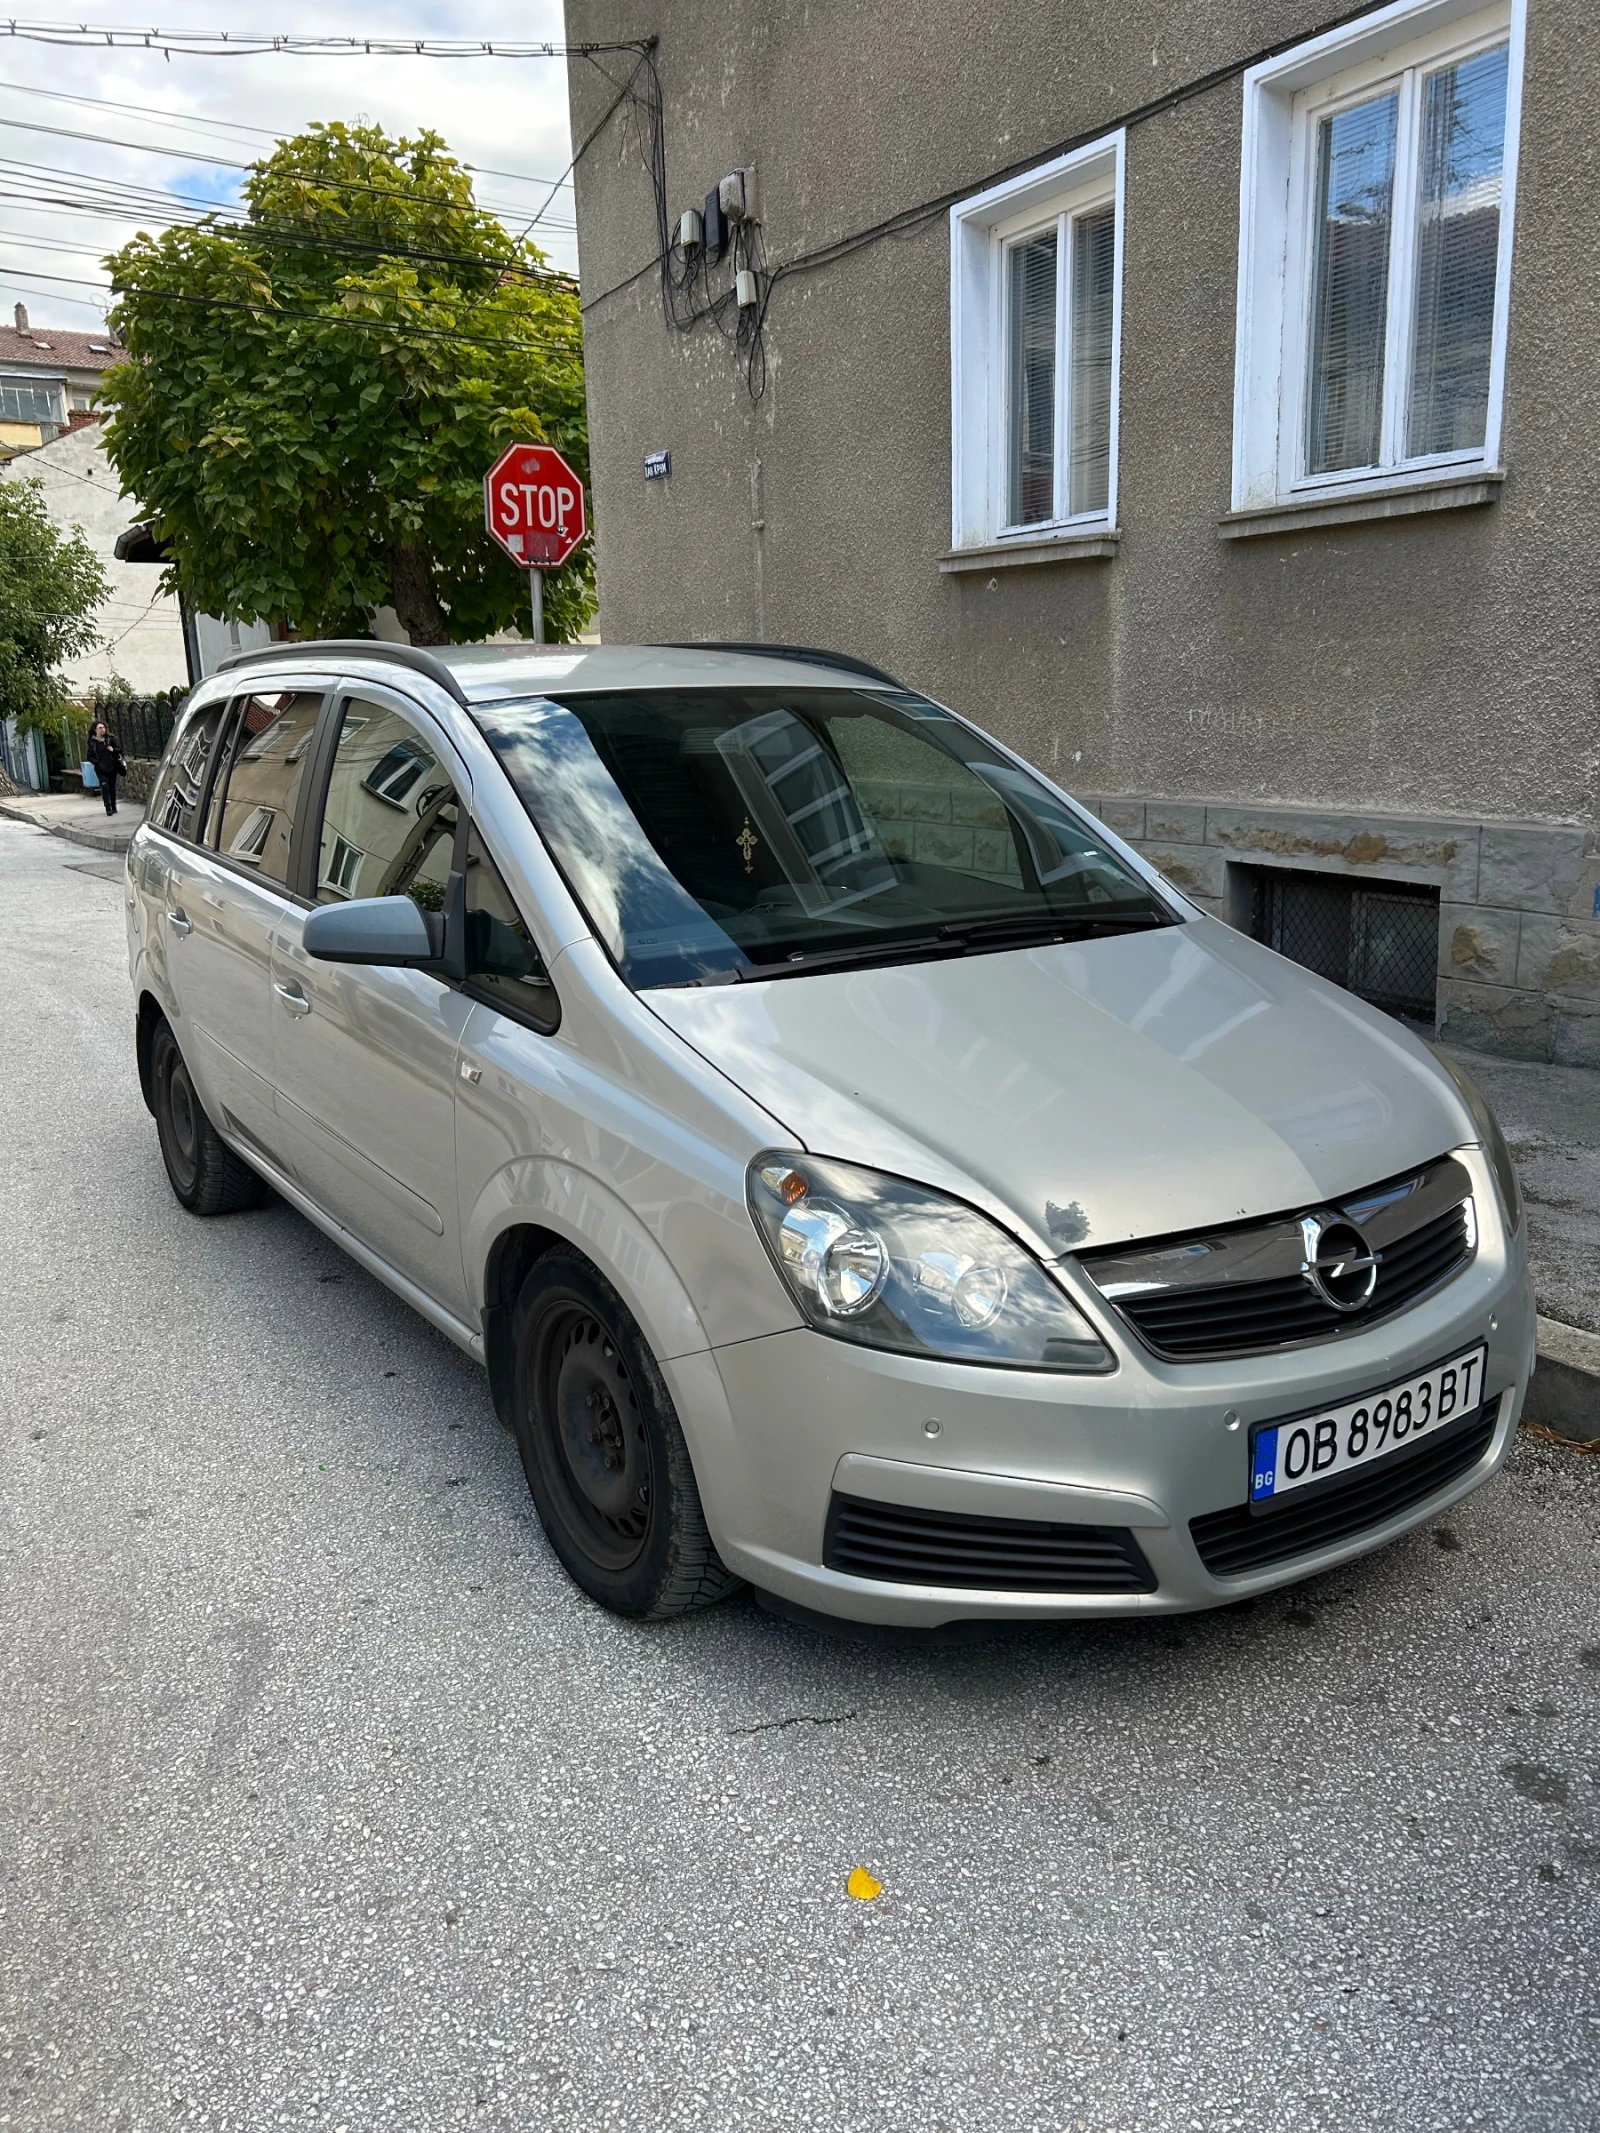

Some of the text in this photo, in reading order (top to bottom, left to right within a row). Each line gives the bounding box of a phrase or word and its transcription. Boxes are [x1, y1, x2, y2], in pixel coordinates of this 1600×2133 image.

[500, 482, 575, 528] STOP
[1284, 1355, 1479, 1479] OB 8983 BT
[1255, 1471, 1274, 1490] BG
